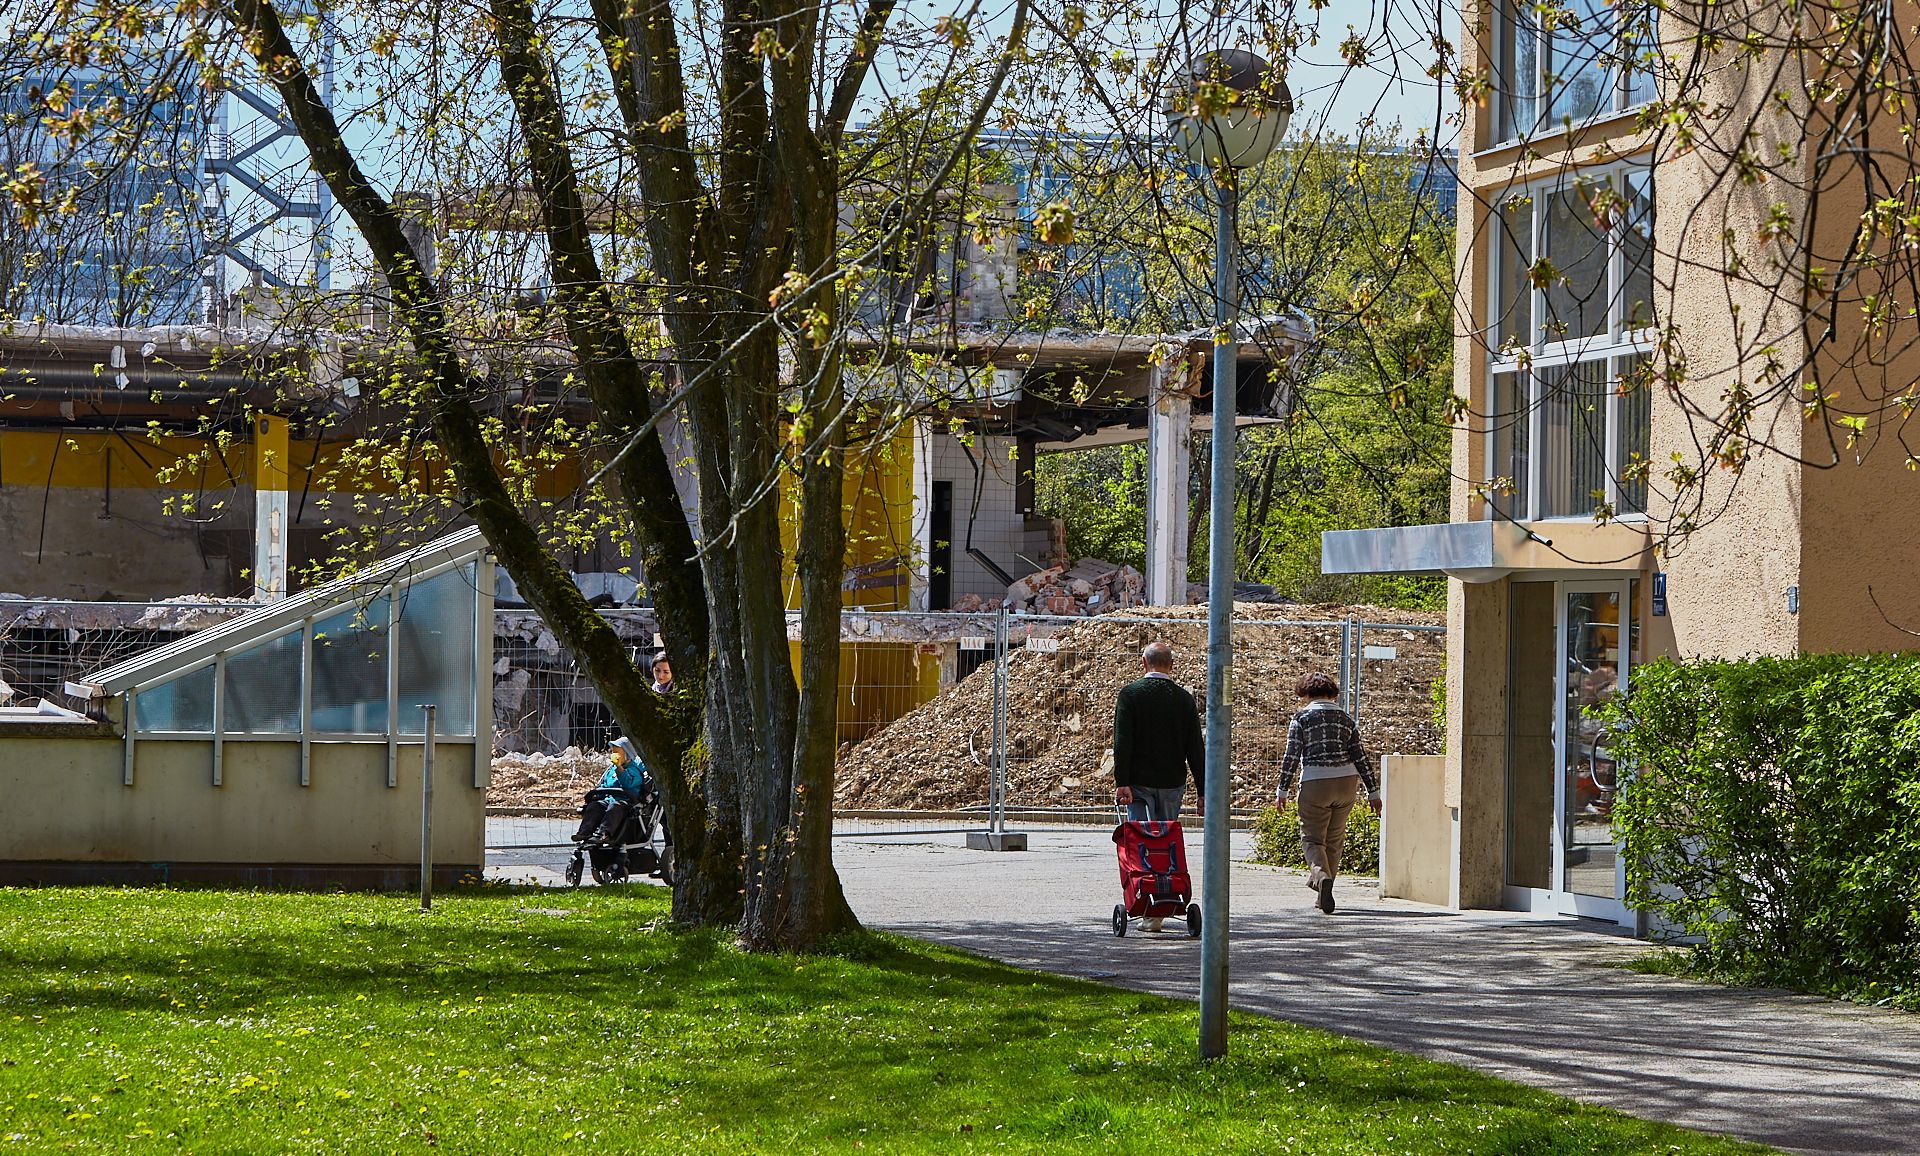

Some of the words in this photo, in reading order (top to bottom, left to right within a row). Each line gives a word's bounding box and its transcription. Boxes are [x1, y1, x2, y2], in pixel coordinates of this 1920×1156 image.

[1654, 576, 1663, 596] 17
[963, 638, 984, 648] MAC
[1029, 639, 1055, 650] MAC
